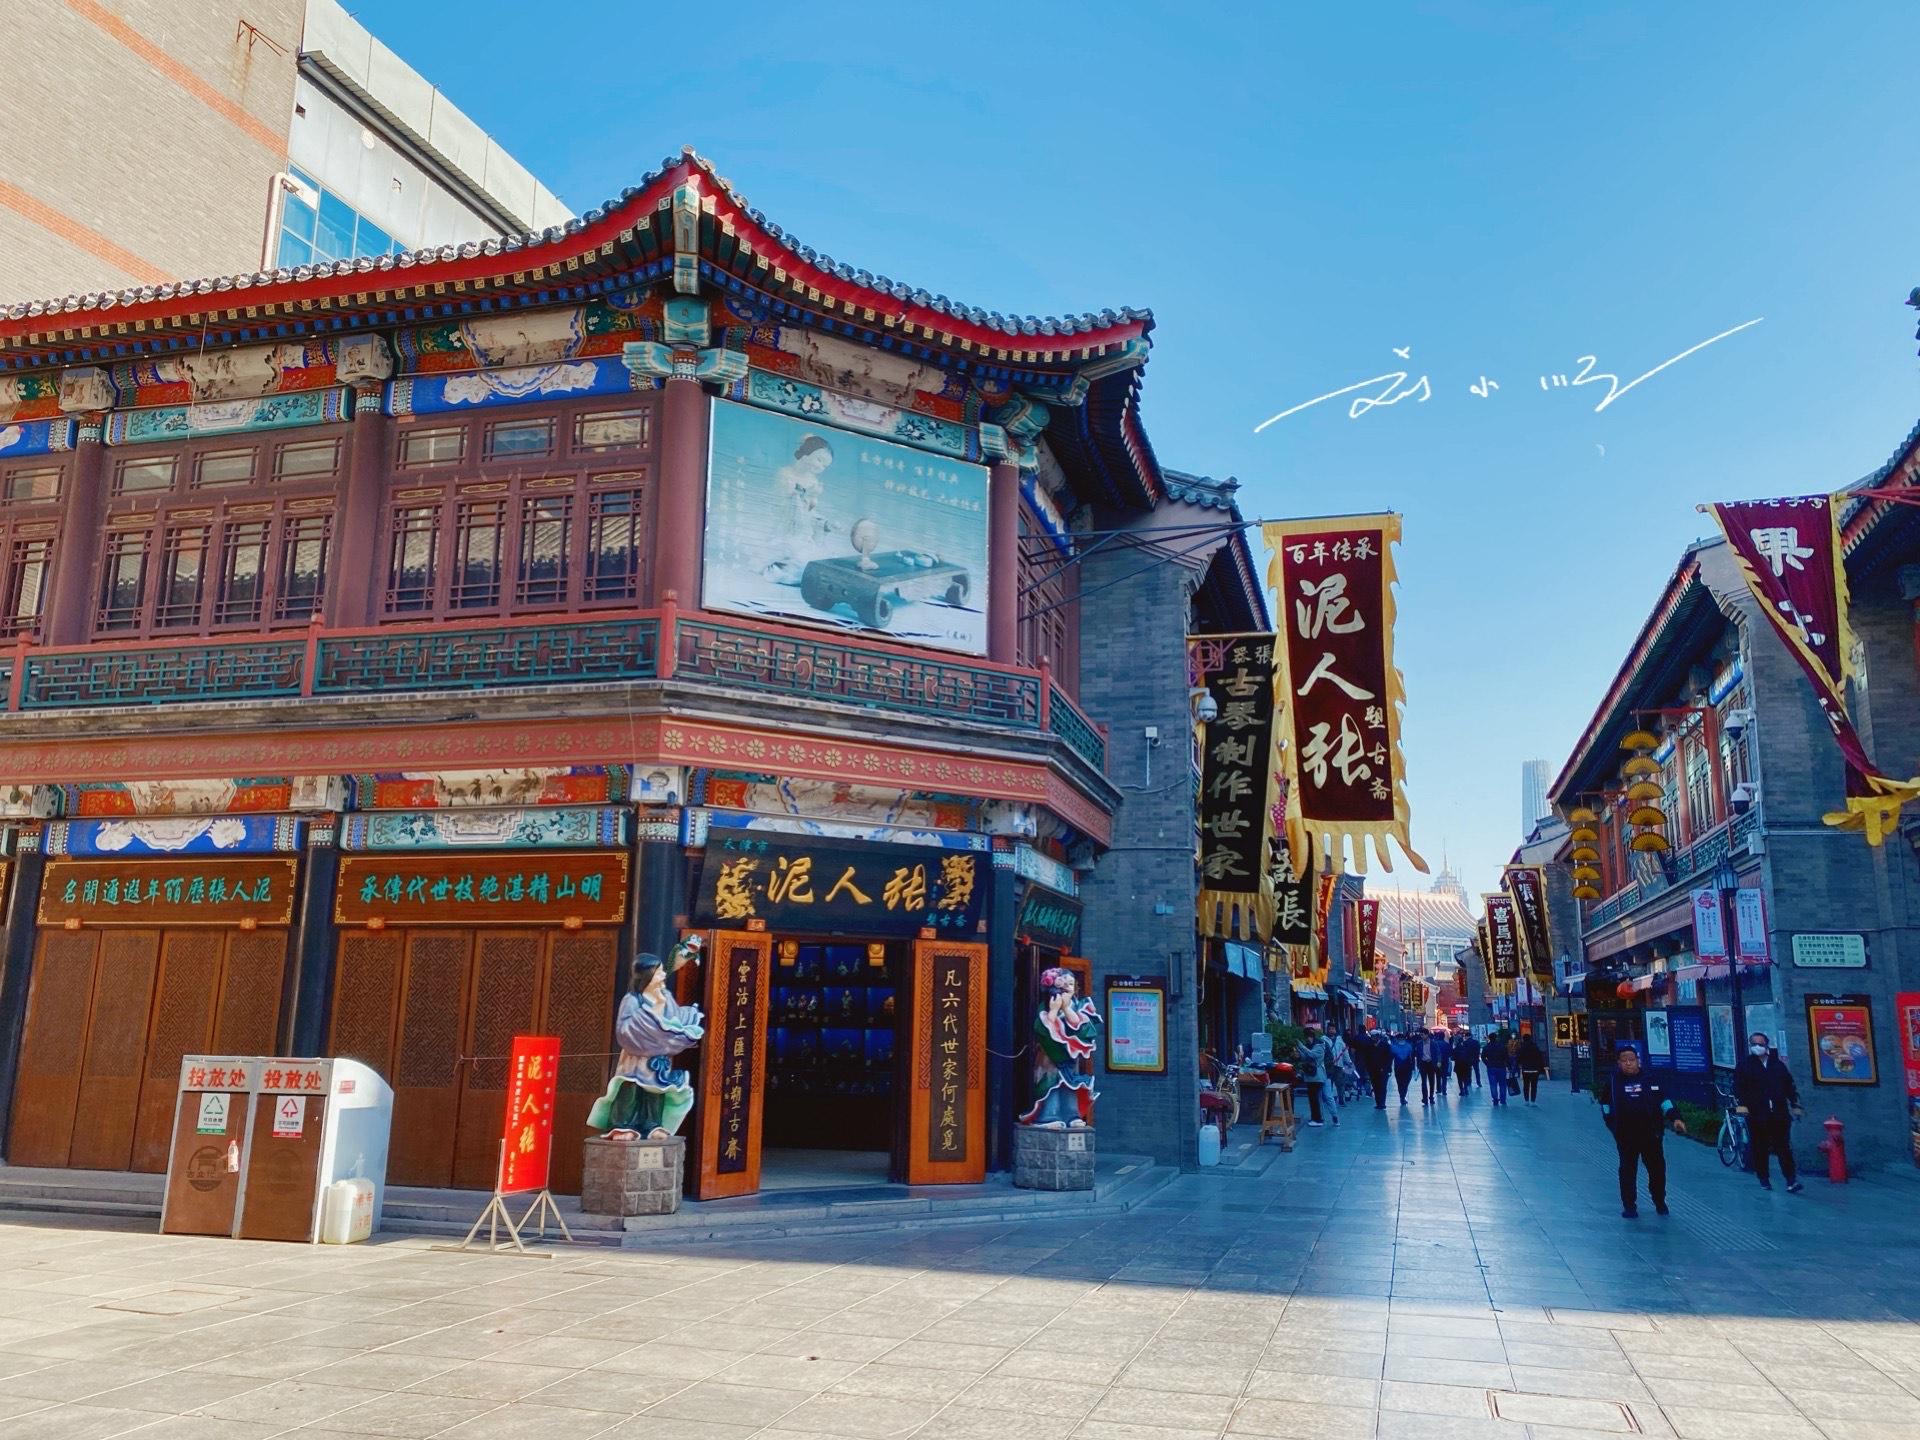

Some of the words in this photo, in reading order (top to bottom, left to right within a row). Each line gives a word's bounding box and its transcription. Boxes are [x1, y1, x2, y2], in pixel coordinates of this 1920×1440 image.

[1285, 536, 1378, 566] 百年传承
[1295, 573, 1376, 789] 泥人张
[1202, 667, 1266, 880] 古琴制作世家
[1365, 705, 1391, 801] 塑古斋
[187, 1066, 246, 1088] 投放处
[263, 1069, 322, 1090] 投放处
